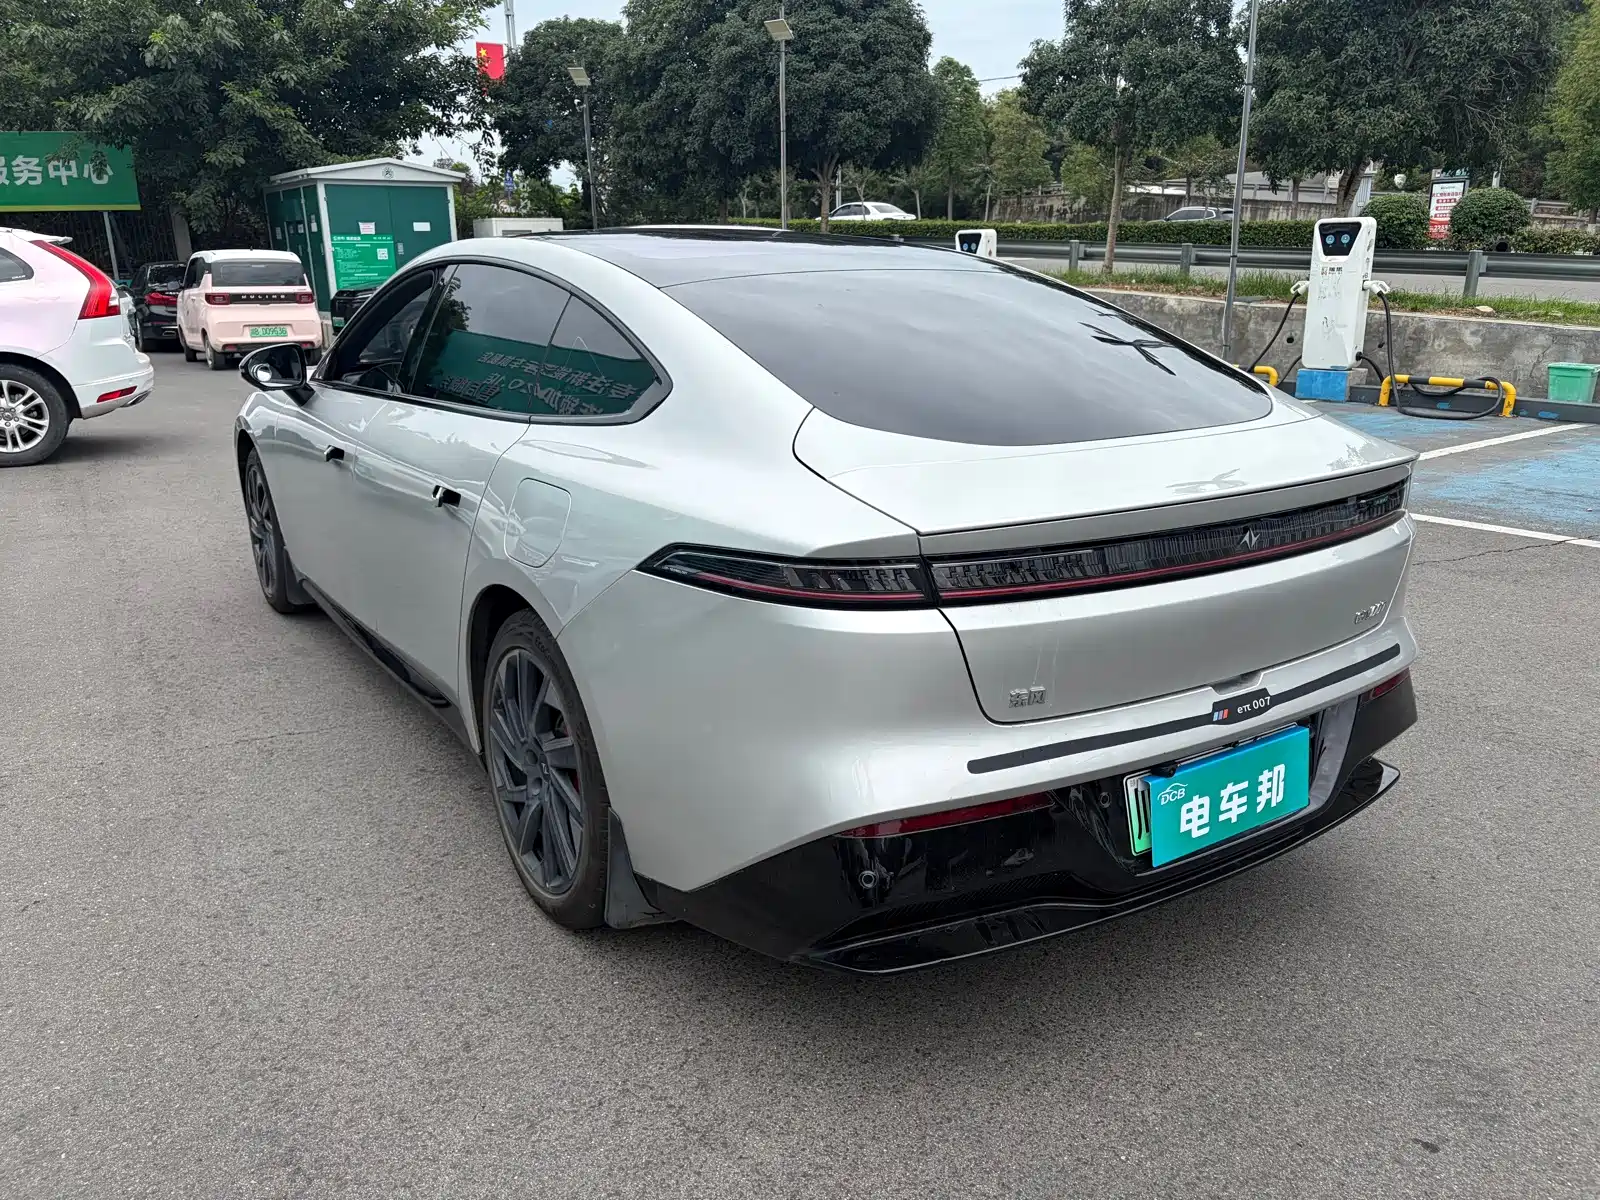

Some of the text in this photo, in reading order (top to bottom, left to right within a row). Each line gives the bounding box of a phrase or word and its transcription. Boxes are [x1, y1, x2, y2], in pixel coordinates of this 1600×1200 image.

[1252, 696, 1271, 709] 007
[1160, 787, 1186, 806] DCB
[1179, 763, 1286, 839] 电车邦
